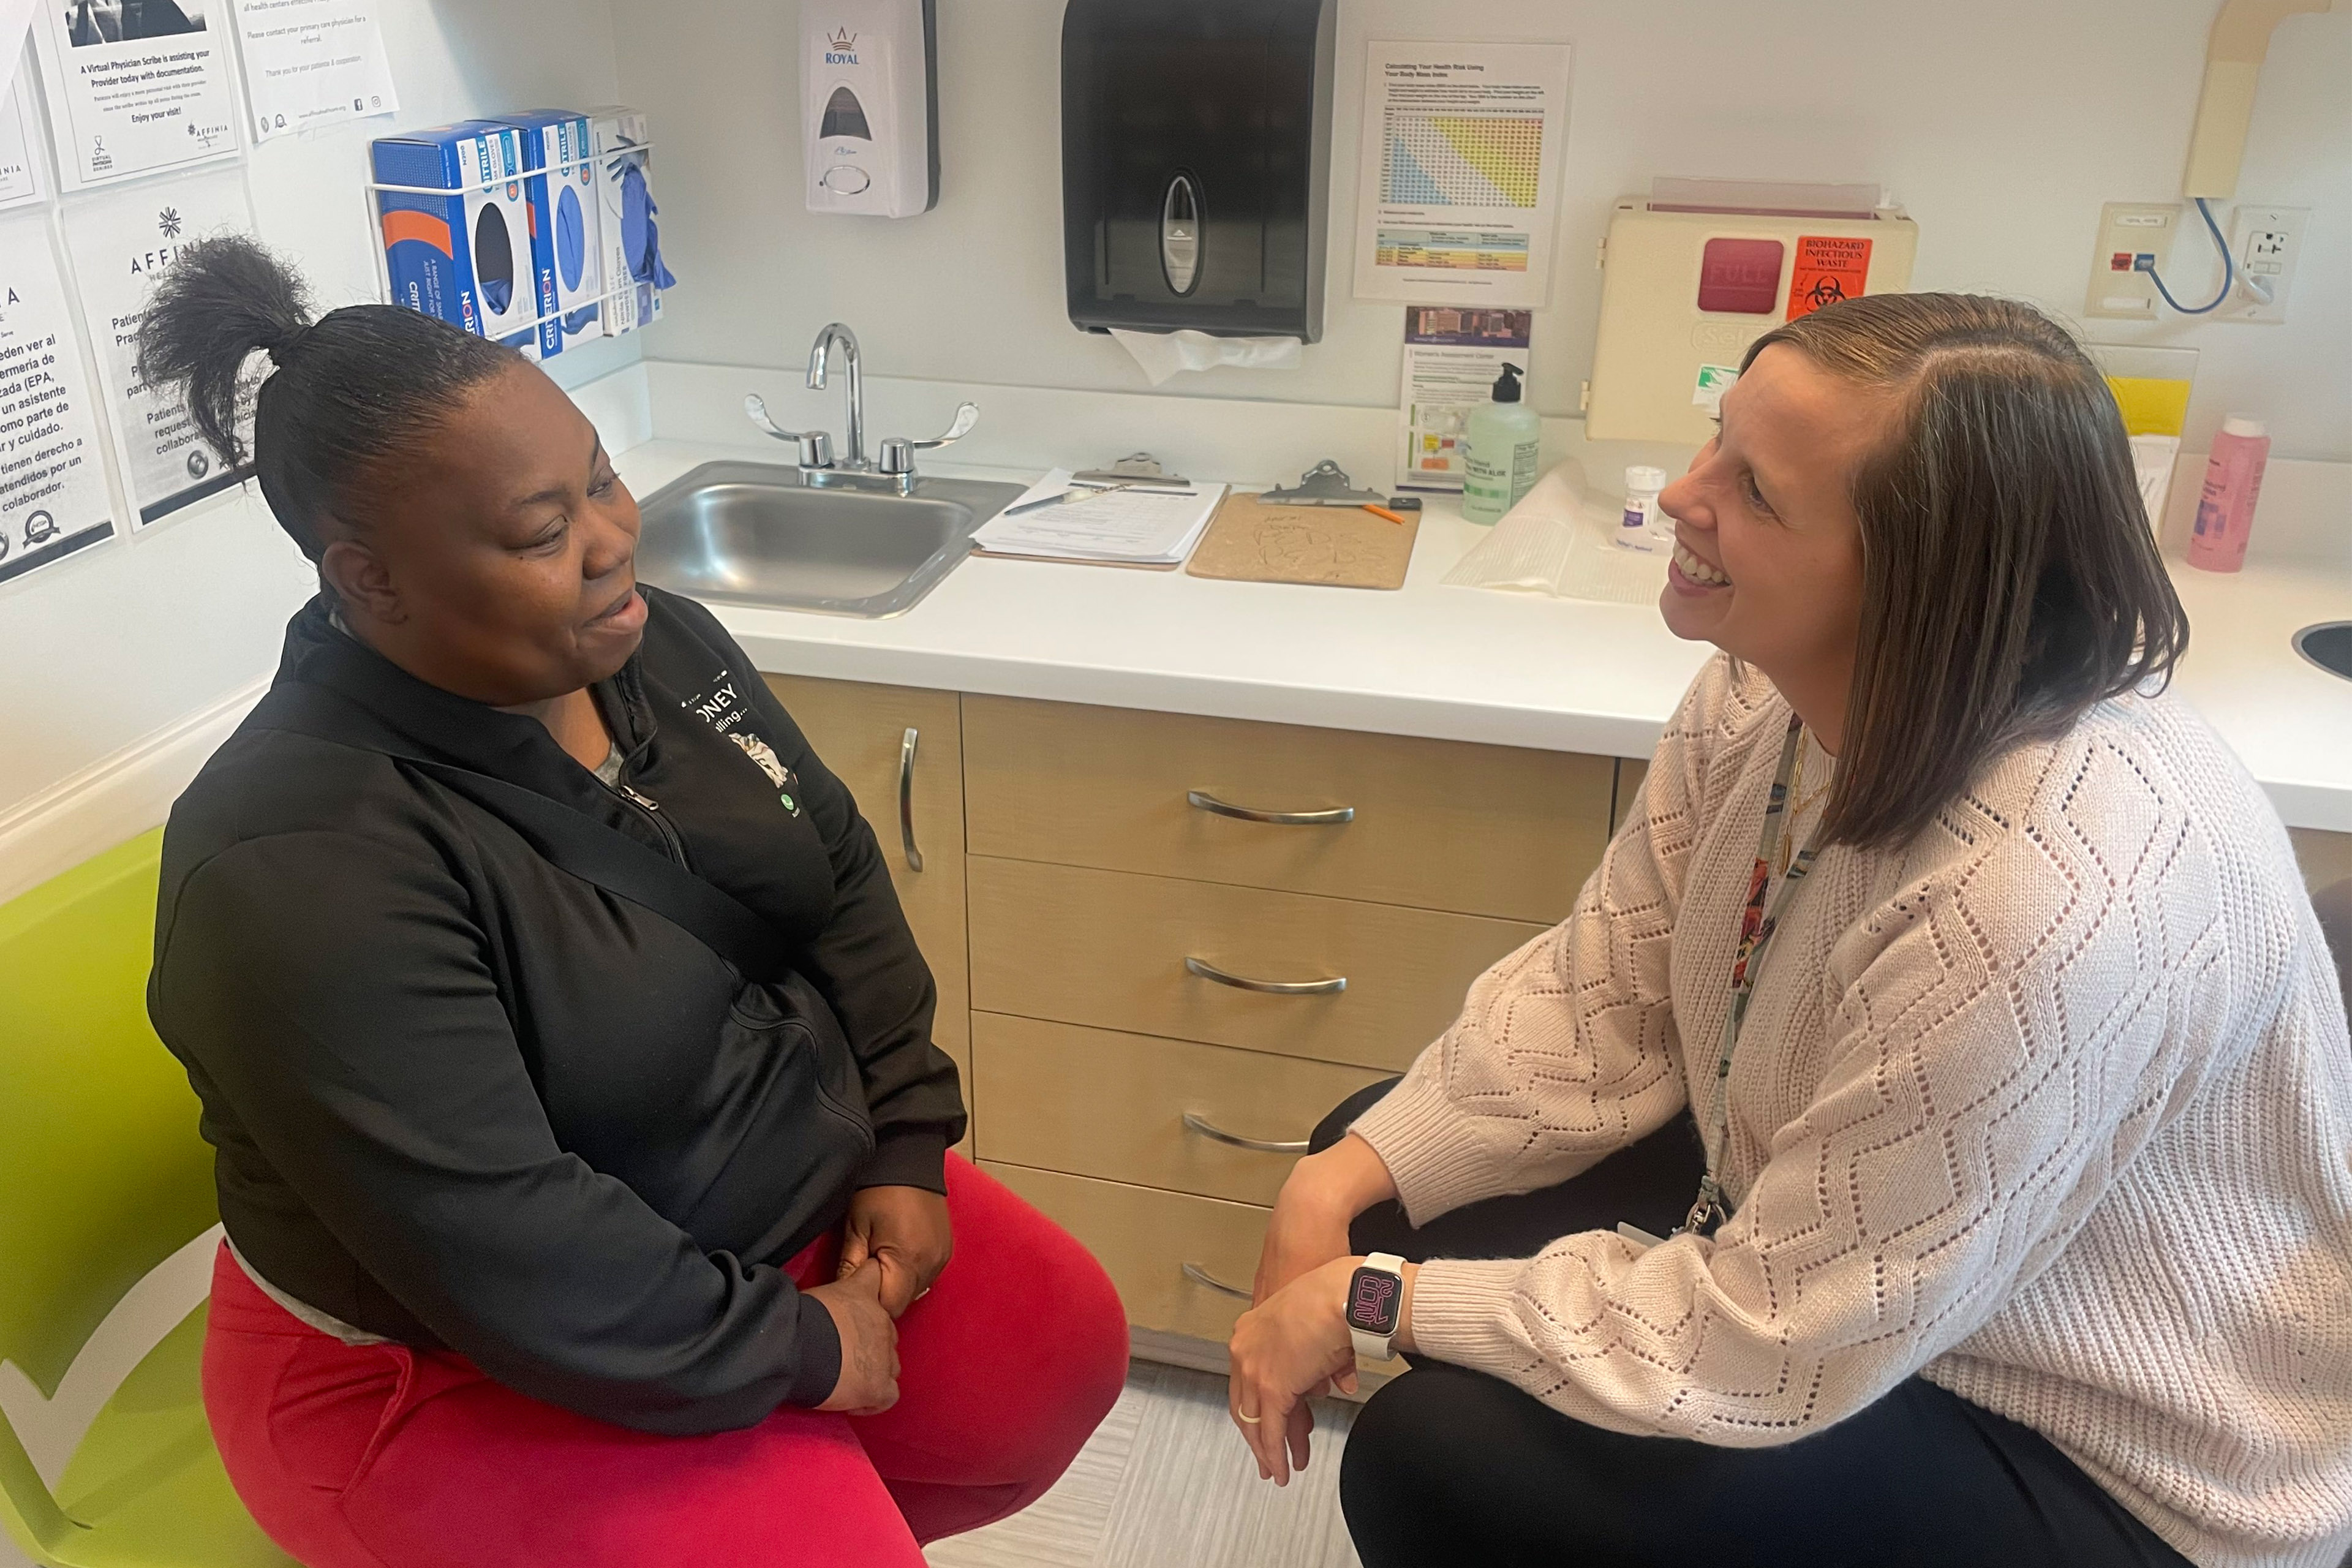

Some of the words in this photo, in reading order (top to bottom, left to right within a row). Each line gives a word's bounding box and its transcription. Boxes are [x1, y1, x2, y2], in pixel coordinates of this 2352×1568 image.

[251, 2, 268, 11] health
[266, 28, 285, 37] contact
[287, 26, 298, 35] your
[300, 23, 319, 32] primary
[331, 18, 354, 28] physician
[301, 36, 322, 45] referral.
[87, 62, 110, 73] Virtual
[111, 58, 141, 70] Physician
[143, 56, 162, 66] Scribe
[163, 54, 168, 62] is
[170, 52, 195, 62] assisting
[196, 50, 209, 60] your
[825, 53, 859, 65] ROYAL
[91, 76, 119, 88] Provider
[120, 74, 139, 85] today
[141, 71, 156, 80] with
[156, 65, 204, 78] documentation.
[266, 69, 281, 78] Thank
[299, 64, 310, 73] your
[132, 114, 149, 123] Enjoy
[151, 111, 165, 120] your
[167, 107, 181, 116] visit!
[197, 124, 228, 137] AFFINIA
[1805, 248, 1863, 259] INFECTIOUS
[1807, 239, 1864, 250] BIOHAZARD
[1816, 258, 1849, 268] WASTE
[434, 290, 441, 300] OF
[112, 309, 148, 330] Patien
[461, 291, 476, 334] RION
[26, 339, 43, 352] ver
[46, 333, 56, 346] al
[42, 353, 55, 366] de
[24, 371, 55, 393] (EPA,
[2, 402, 16, 415] un
[18, 386, 66, 410] asistente
[26, 407, 54, 427] parte
[56, 401, 70, 413] de
[9, 439, 15, 452] y
[18, 421, 64, 446] cuidado.
[156, 432, 200, 455] collabora
[1, 456, 32, 475] tienen
[34, 440, 74, 462] derecho
[77, 437, 83, 447] a
[50, 461, 67, 477] por
[69, 456, 82, 467] un
[2, 481, 65, 512] colaborador.
